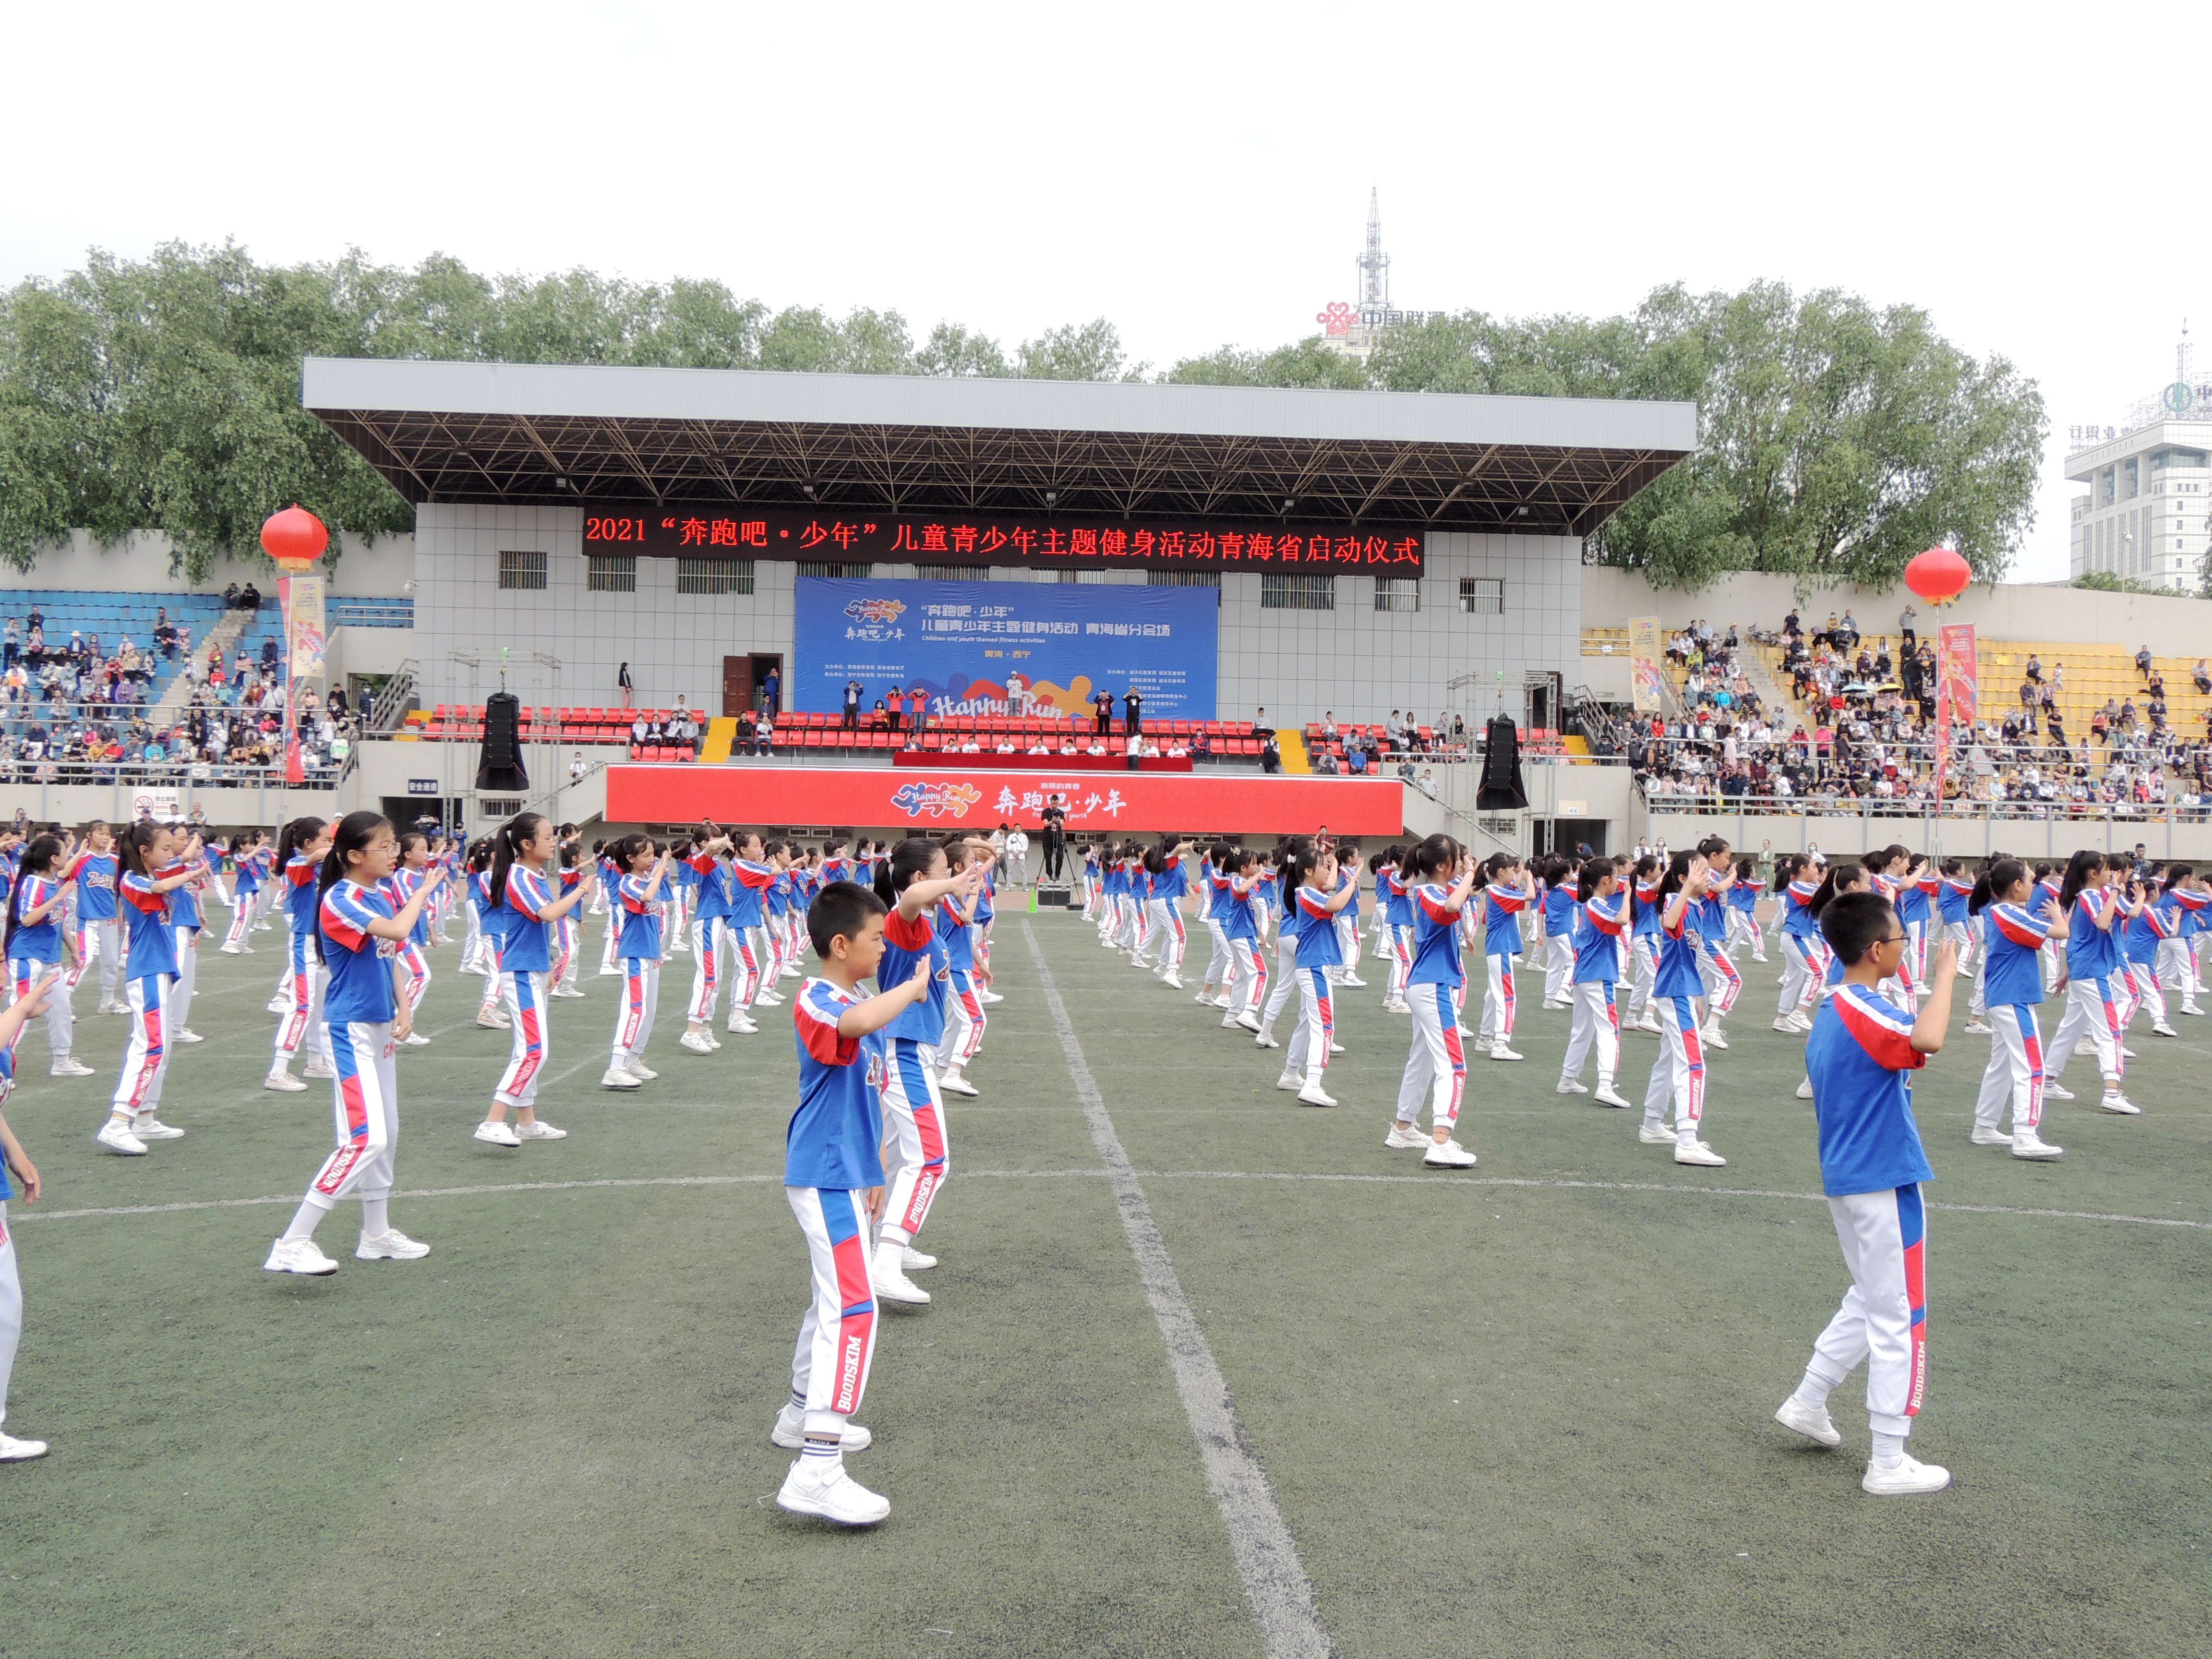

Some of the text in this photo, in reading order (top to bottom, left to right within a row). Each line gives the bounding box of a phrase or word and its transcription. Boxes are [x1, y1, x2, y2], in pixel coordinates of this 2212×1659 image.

[921, 619, 1170, 637] 儿童青少年主题健身活动 青海省分会场
[911, 790, 961, 803] Happy Run
[1068, 811, 1088, 822] youth
[626, 1012, 639, 1045] BOODSKIM
[1692, 1078, 1700, 1117] BOODSKIM
[908, 1171, 935, 1225] BOODSKIM
[837, 1334, 862, 1412] BOODSKIM
